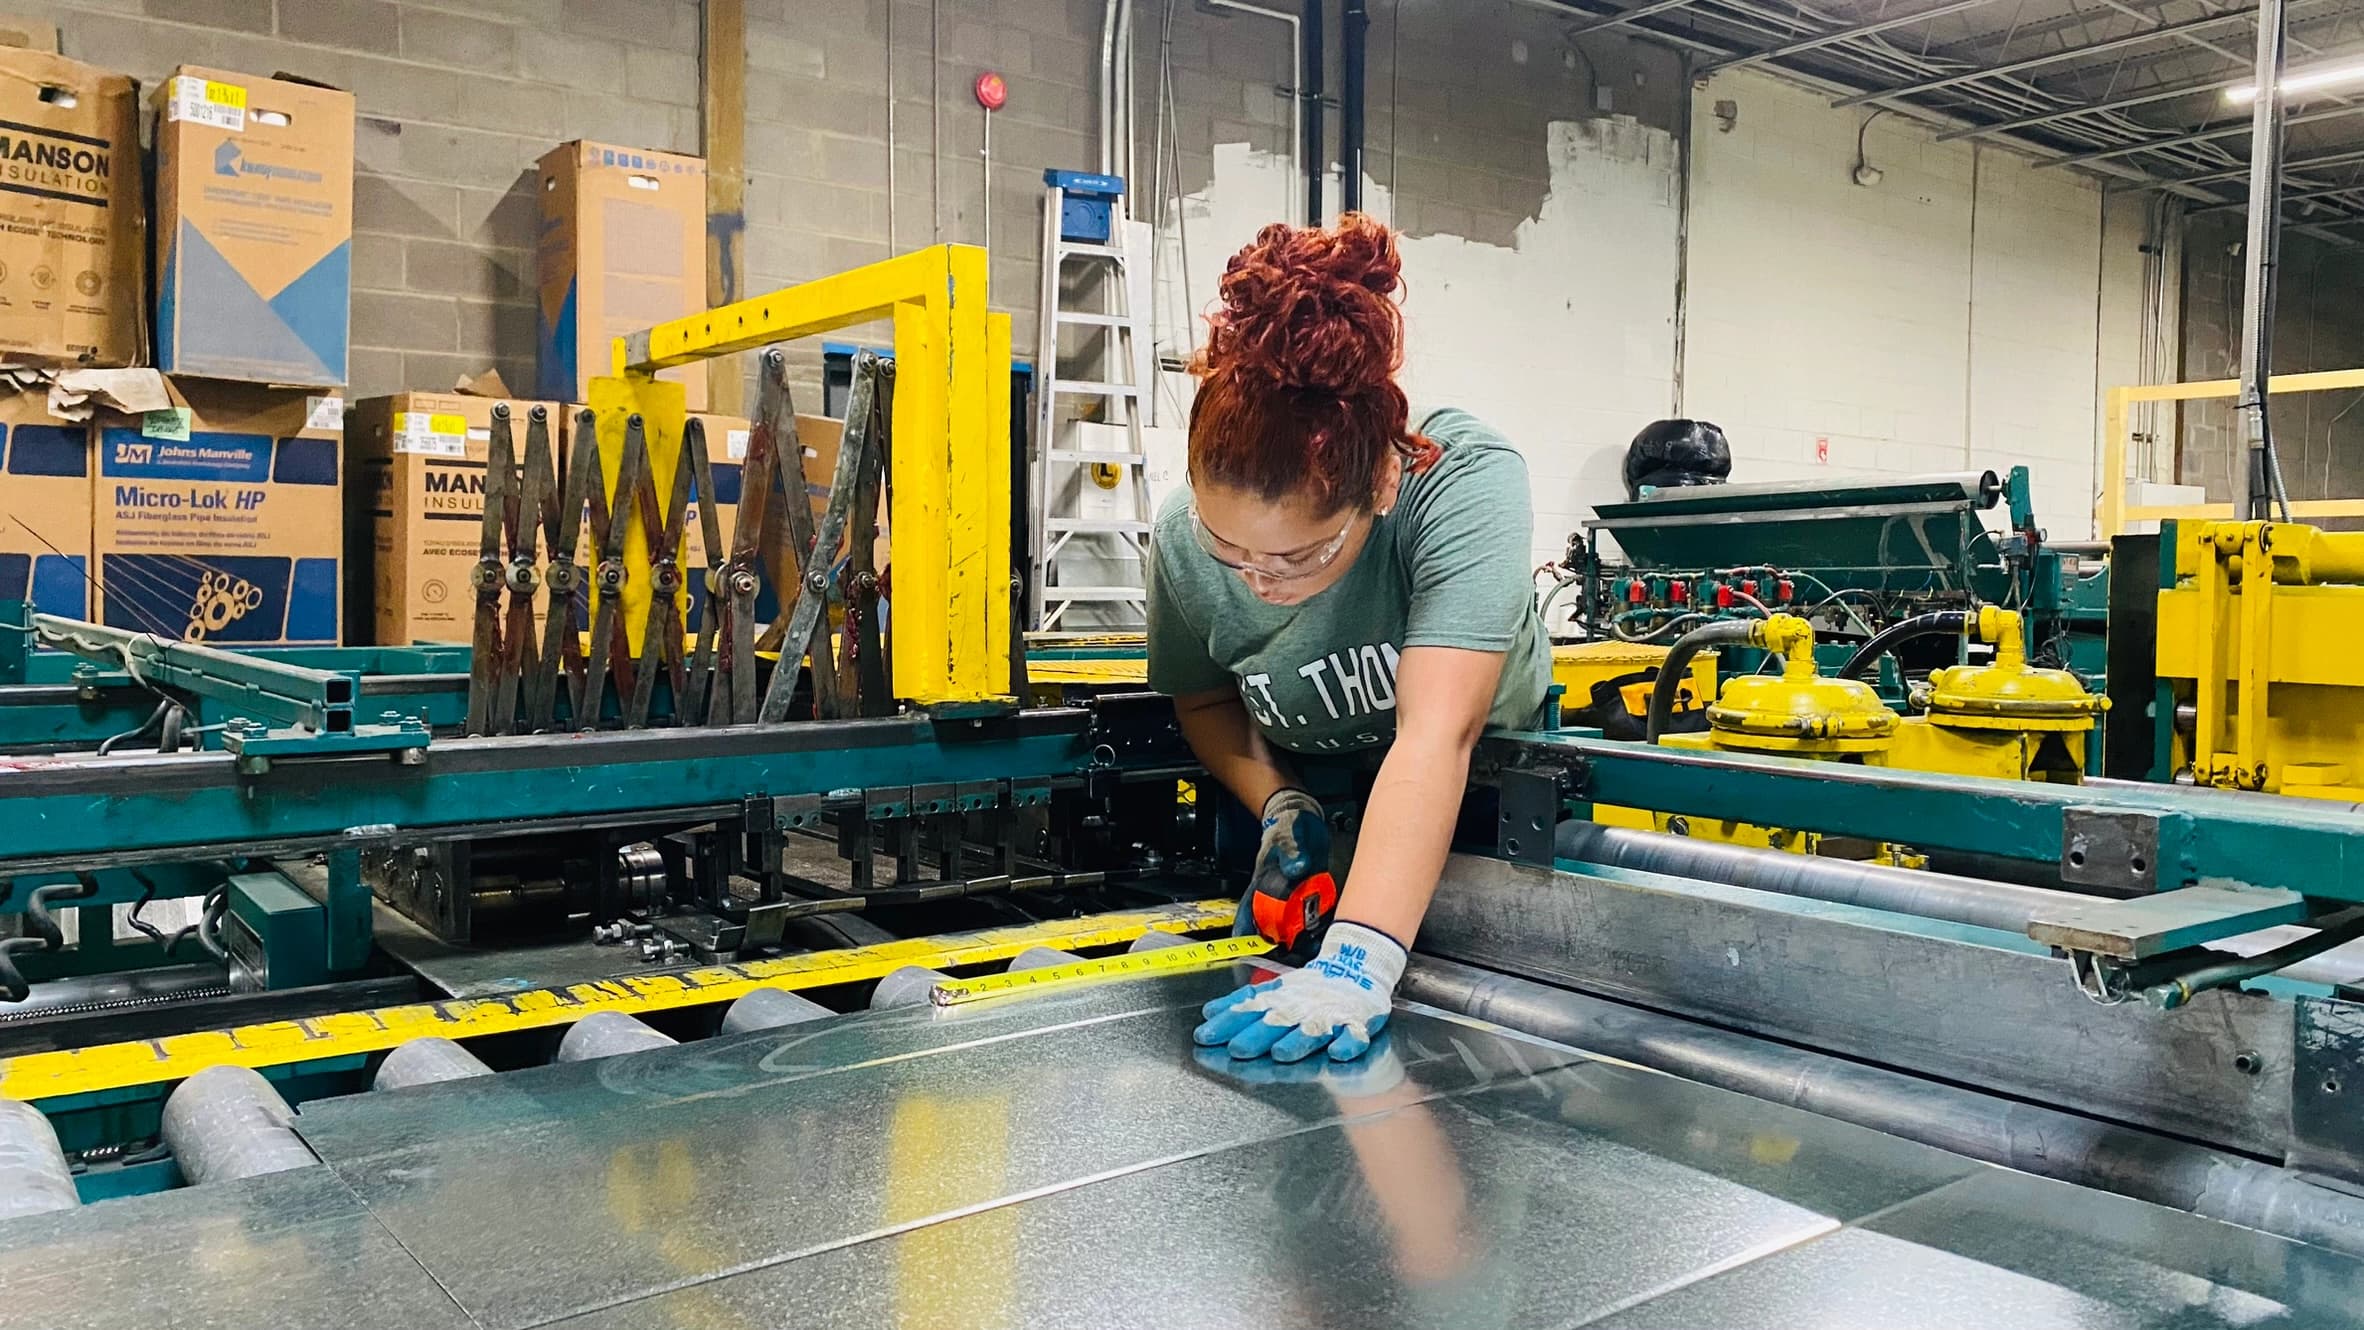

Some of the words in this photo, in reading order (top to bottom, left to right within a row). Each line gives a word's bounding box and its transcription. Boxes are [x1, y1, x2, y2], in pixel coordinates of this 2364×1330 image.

[0, 164, 108, 193] SULATION
[159, 446, 197, 459] Johns
[199, 449, 252, 461] Manville
[425, 472, 486, 494] MAN
[115, 486, 227, 510] Micro-Lok
[235, 490, 265, 510] HP
[424, 496, 483, 510] INSUL
[980, 984, 986, 992] 2
[1005, 979, 1013, 988] 3
[1029, 975, 1037, 984] 4
[1053, 971, 1060, 980] 5
[1076, 967, 1084, 976] 6
[1099, 964, 1105, 972] 7
[1121, 960, 1129, 969] 8
[1142, 957, 1150, 966] 9
[1166, 953, 1178, 962] 10
[1227, 942, 1240, 952] 13
[1247, 940, 1259, 949] 14
